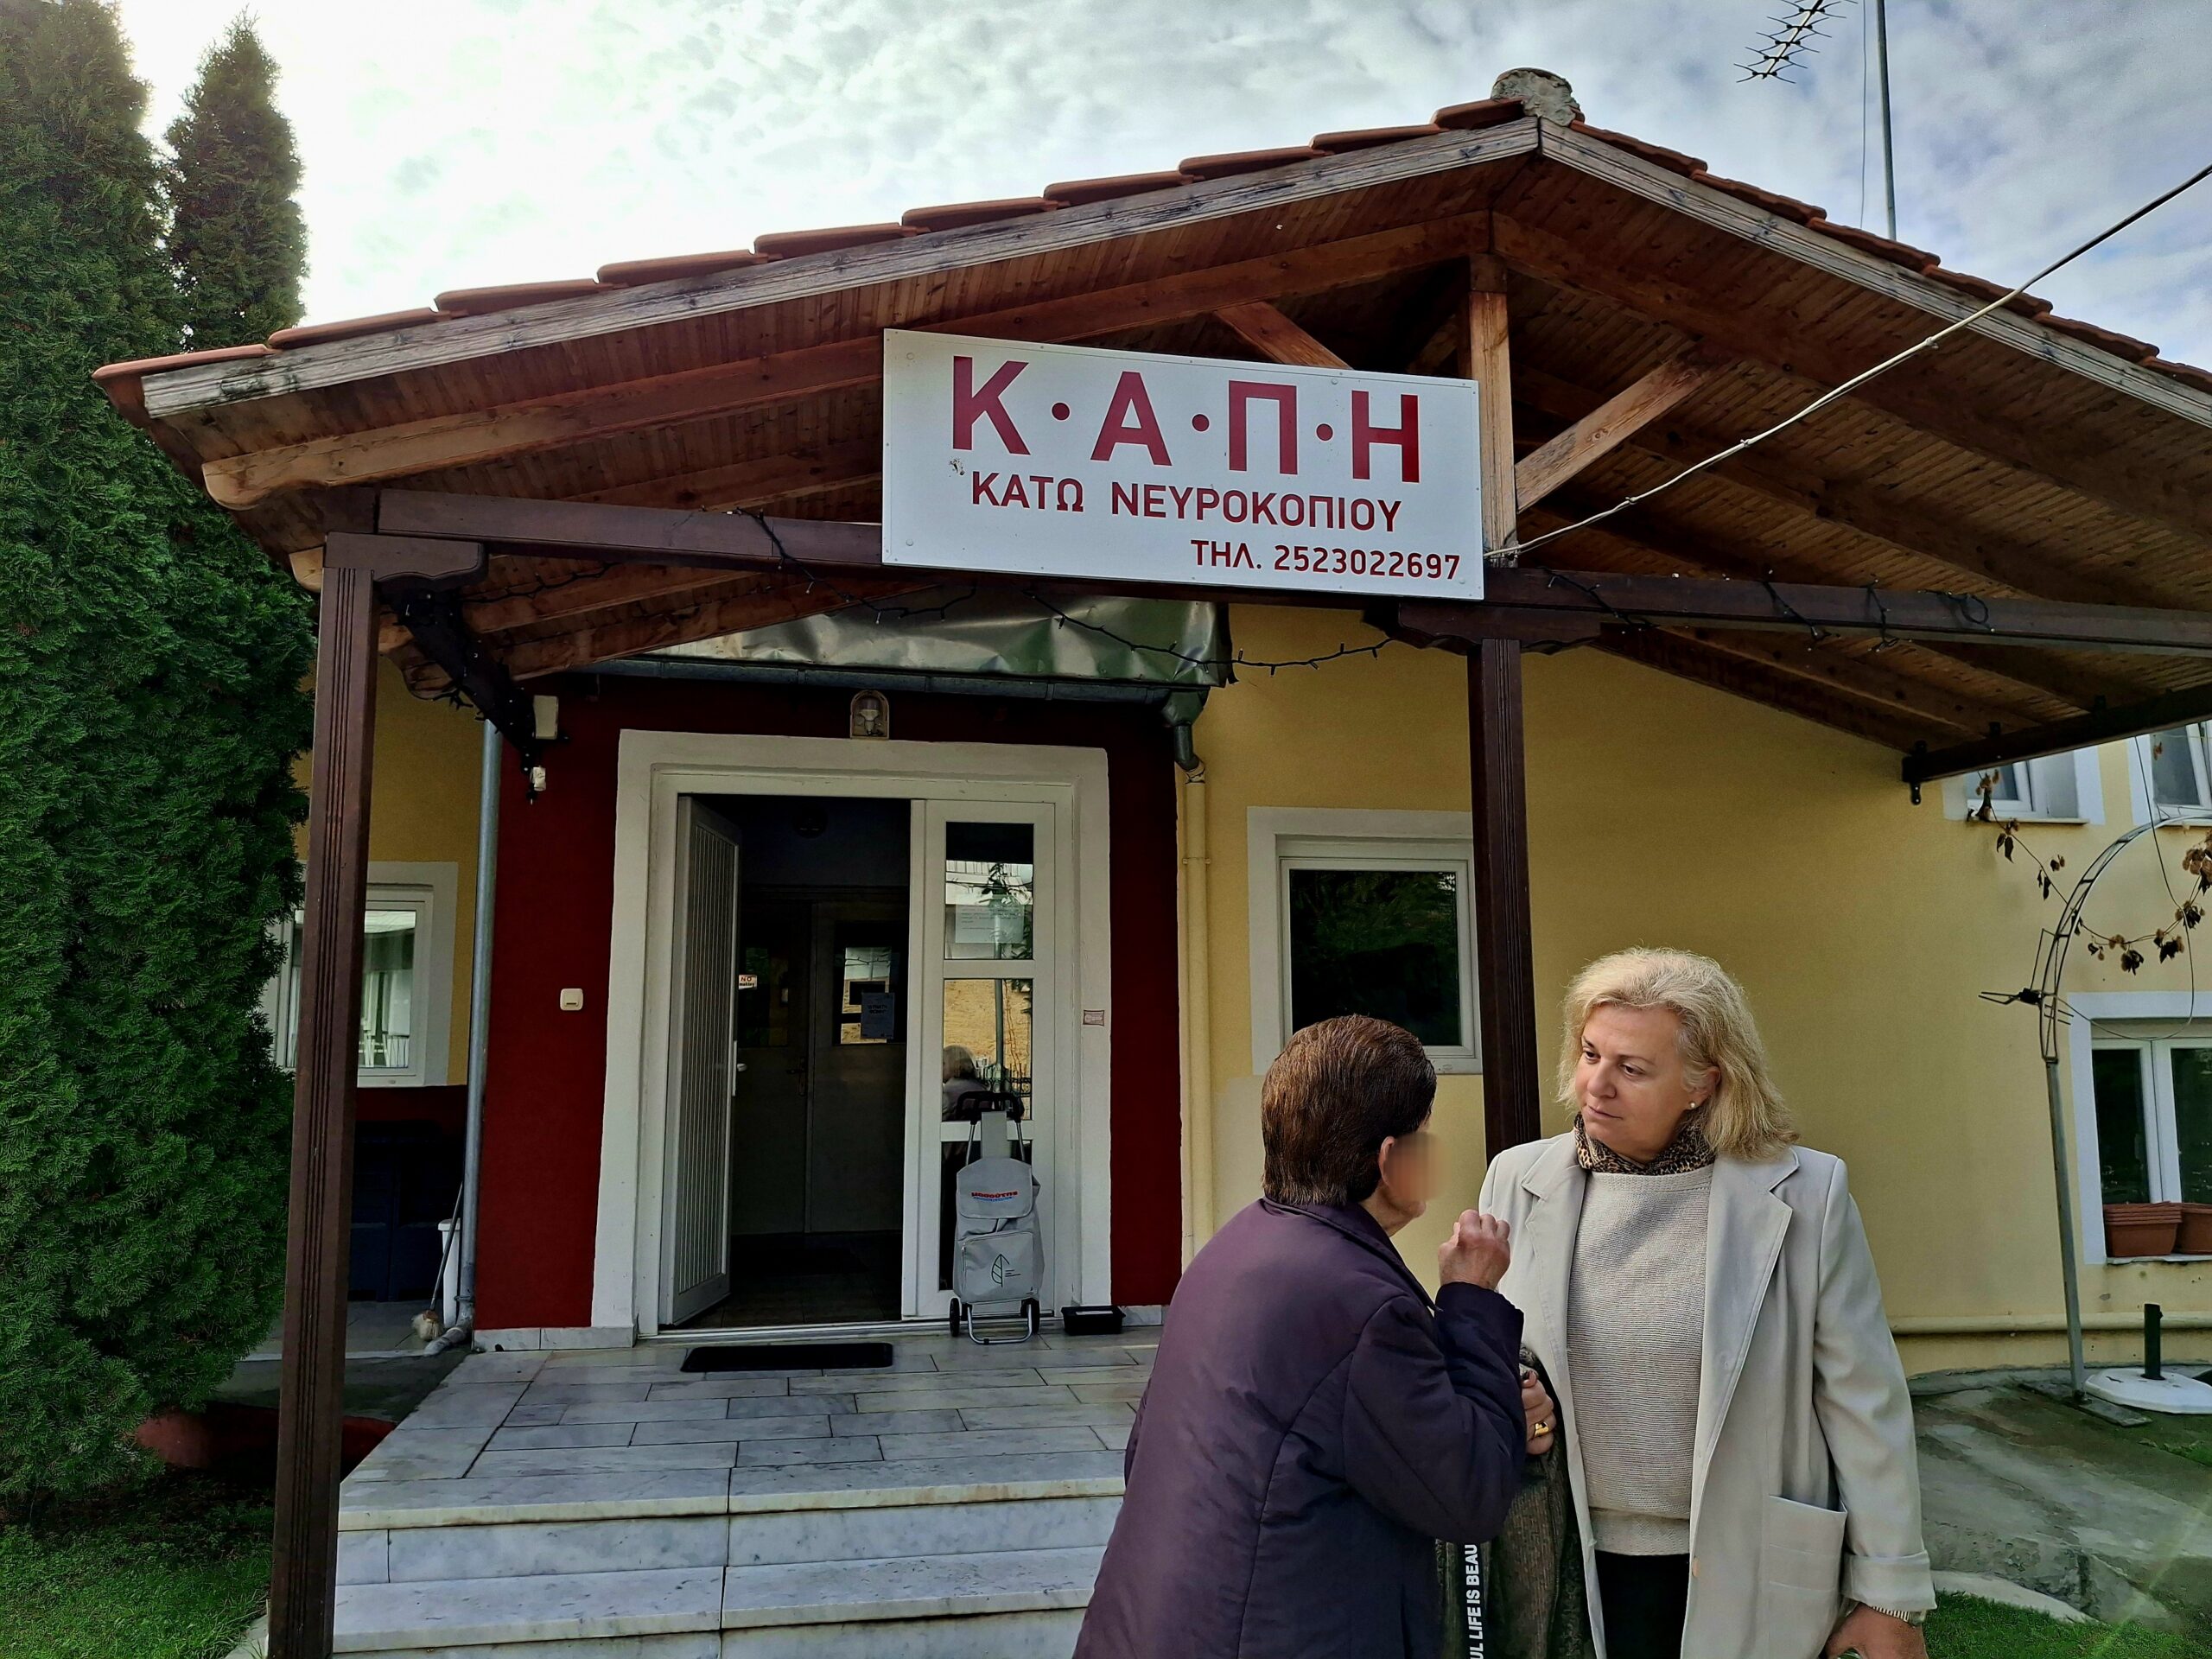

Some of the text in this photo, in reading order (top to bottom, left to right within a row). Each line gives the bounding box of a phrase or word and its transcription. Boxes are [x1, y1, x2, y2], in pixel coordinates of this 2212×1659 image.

[972, 472, 1402, 533] ΚΑΤΩ ΝΕΥΡΟΚΟΠΙΟΥ
[1191, 539, 1460, 581] ΤΗΛ. 2523022697
[1464, 1544, 1480, 1586] BEAU
[1465, 1589, 1481, 1605] IS
[1466, 1606, 1484, 1640] LIFE
